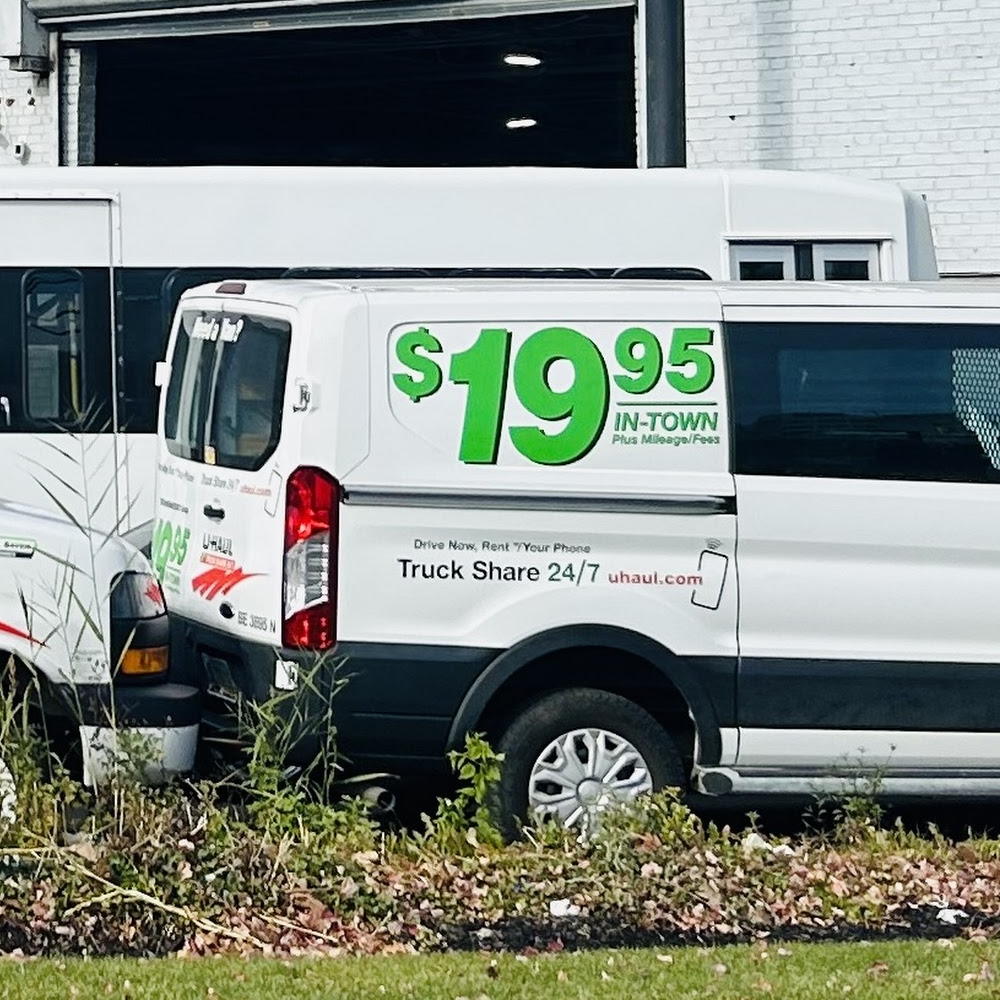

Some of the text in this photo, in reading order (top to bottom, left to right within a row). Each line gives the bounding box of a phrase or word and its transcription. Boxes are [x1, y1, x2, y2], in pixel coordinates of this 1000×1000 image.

[614, 411, 719, 432] IN-TOWN
[612, 434, 720, 447] Plus Mileage/Fees
[414, 539, 445, 550] Drive
[482, 541, 509, 552] Rent
[553, 543, 591, 554] Phone
[397, 558, 703, 587] Truck Share 24/7 uhaul.com
